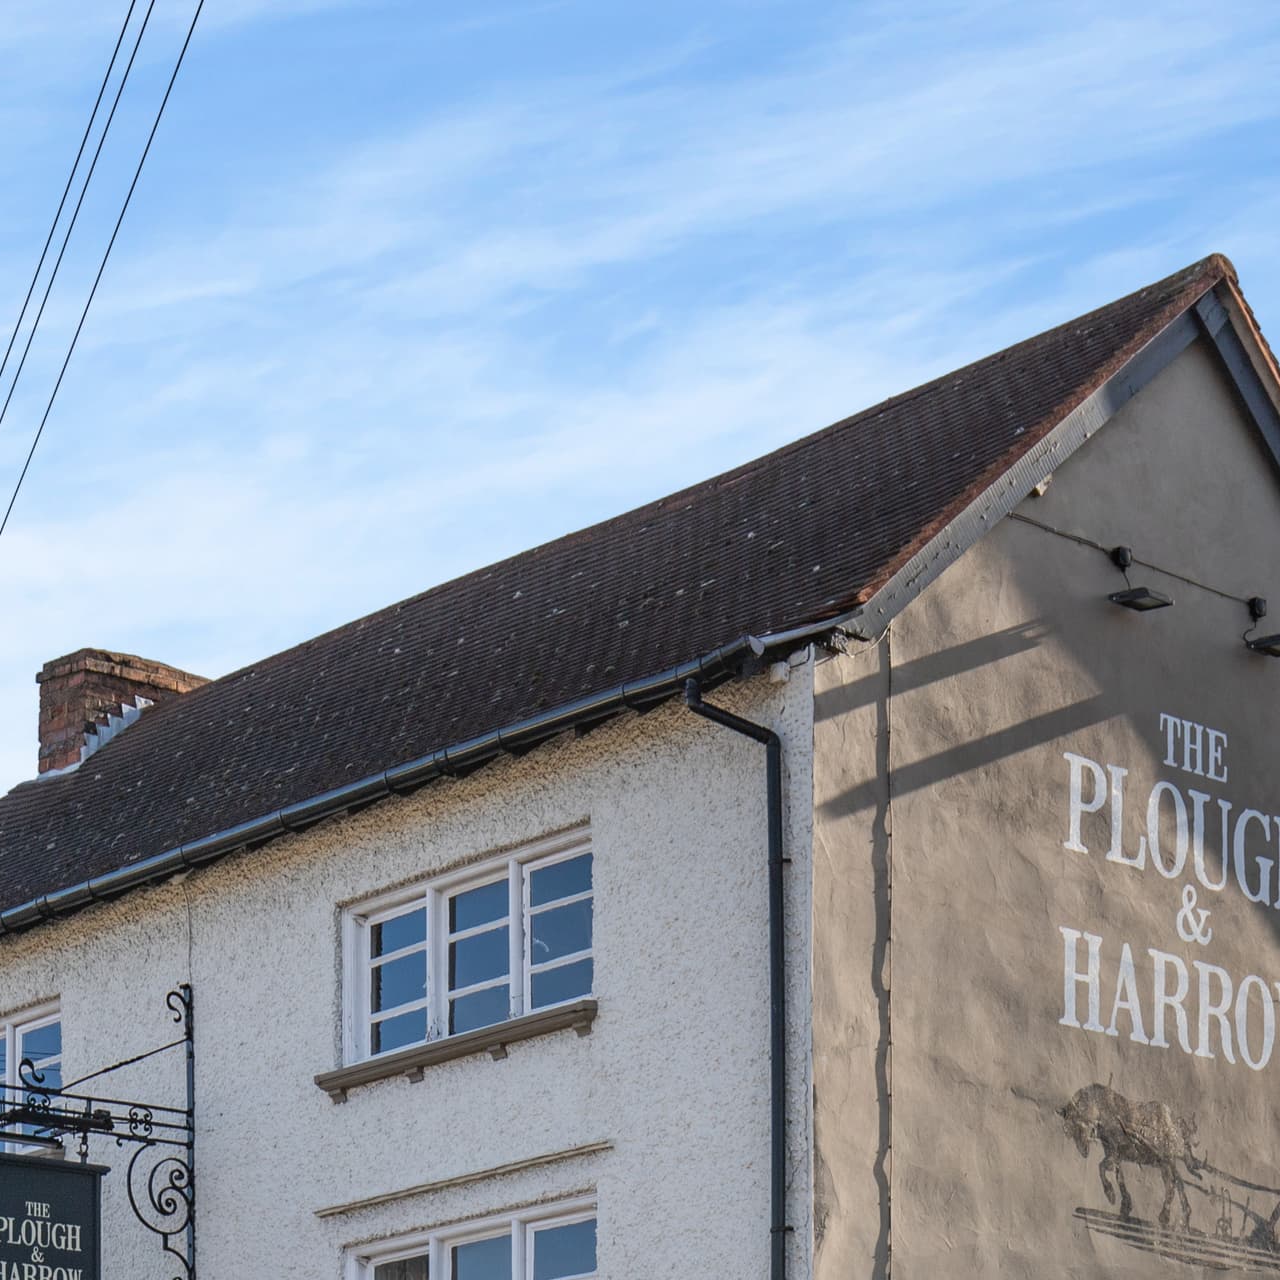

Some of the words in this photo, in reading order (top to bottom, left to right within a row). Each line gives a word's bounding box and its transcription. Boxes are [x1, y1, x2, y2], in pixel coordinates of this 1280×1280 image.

[1159, 713, 1228, 783] THE
[1176, 884, 1213, 946] &
[25, 1201, 50, 1218] THE
[31, 1246, 45, 1263] &
